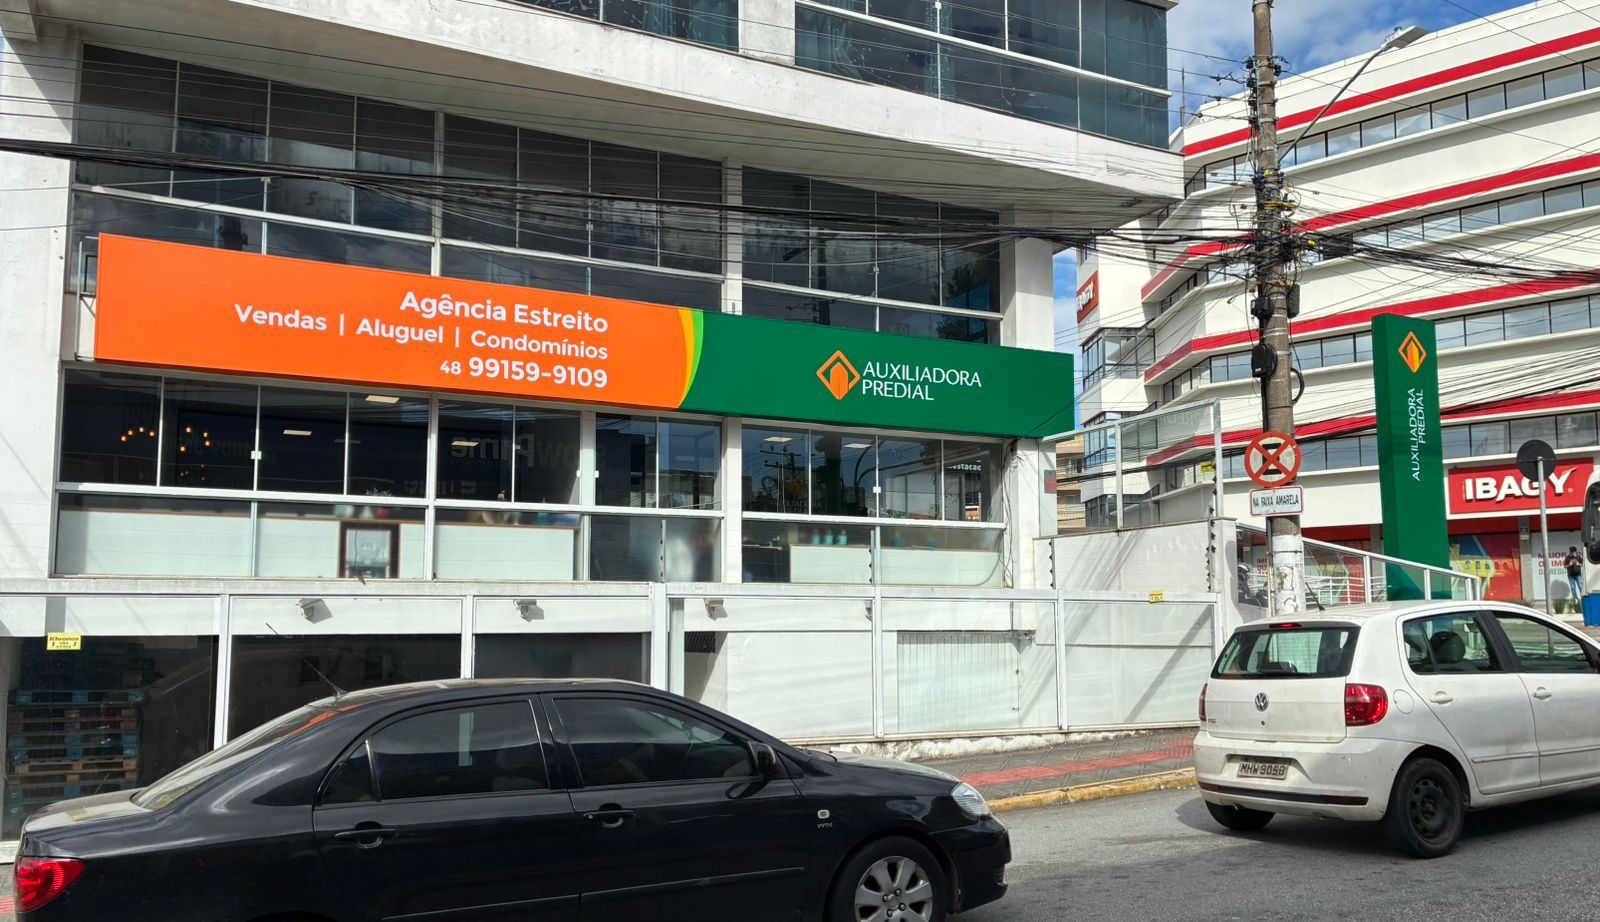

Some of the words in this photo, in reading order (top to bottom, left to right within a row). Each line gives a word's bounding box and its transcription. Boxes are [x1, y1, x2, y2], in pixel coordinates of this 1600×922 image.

[400, 291, 507, 320] Agência
[514, 304, 609, 332] Estreito
[234, 304, 327, 330] Vendas
[356, 318, 443, 343] Aluguel
[471, 330, 608, 360] Condomínios
[440, 360, 461, 375] 48
[469, 357, 608, 388] 99159-9109
[862, 361, 982, 387] AUXILIADORA
[862, 379, 935, 401] PREDIAL
[1416, 389, 1426, 443] PREDIAL
[1407, 388, 1421, 481] AUXILIADORA
[1253, 497, 1259, 507] NA
[1260, 496, 1274, 507] FAIXA
[1275, 494, 1299, 505] AMARELA
[1465, 466, 1577, 502] IBAGY
[1240, 763, 1259, 774] MHW
[1260, 765, 1286, 776] 9058
